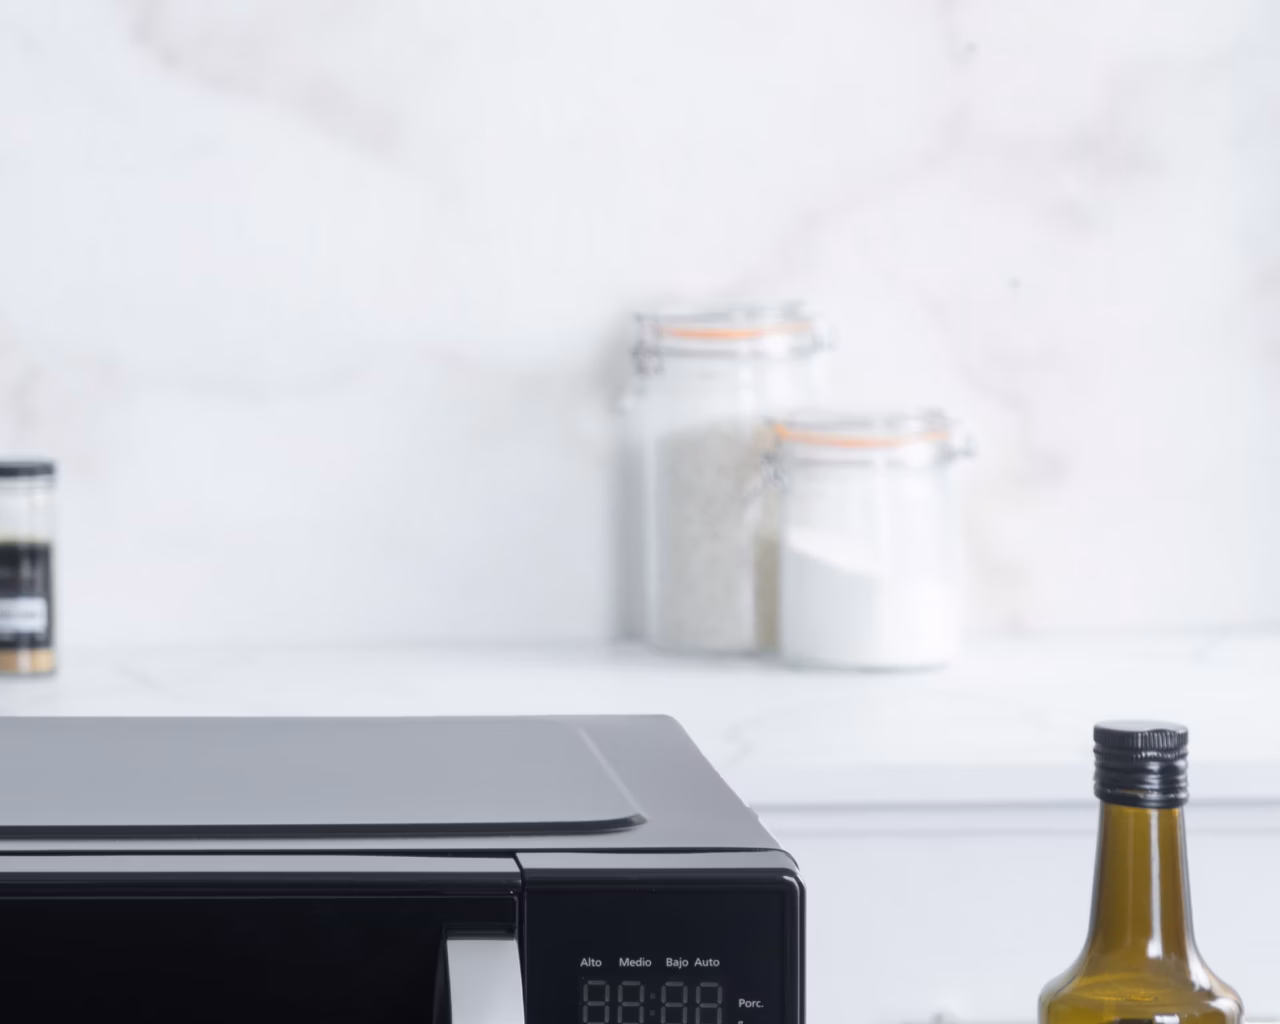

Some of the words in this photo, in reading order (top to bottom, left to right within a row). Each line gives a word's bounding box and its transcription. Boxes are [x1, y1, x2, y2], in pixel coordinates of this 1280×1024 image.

[579, 957, 603, 968] Alto
[618, 957, 652, 968] Medio
[665, 957, 689, 970] Bajo
[693, 958, 721, 968] Auto
[738, 999, 764, 1009] Porc.
